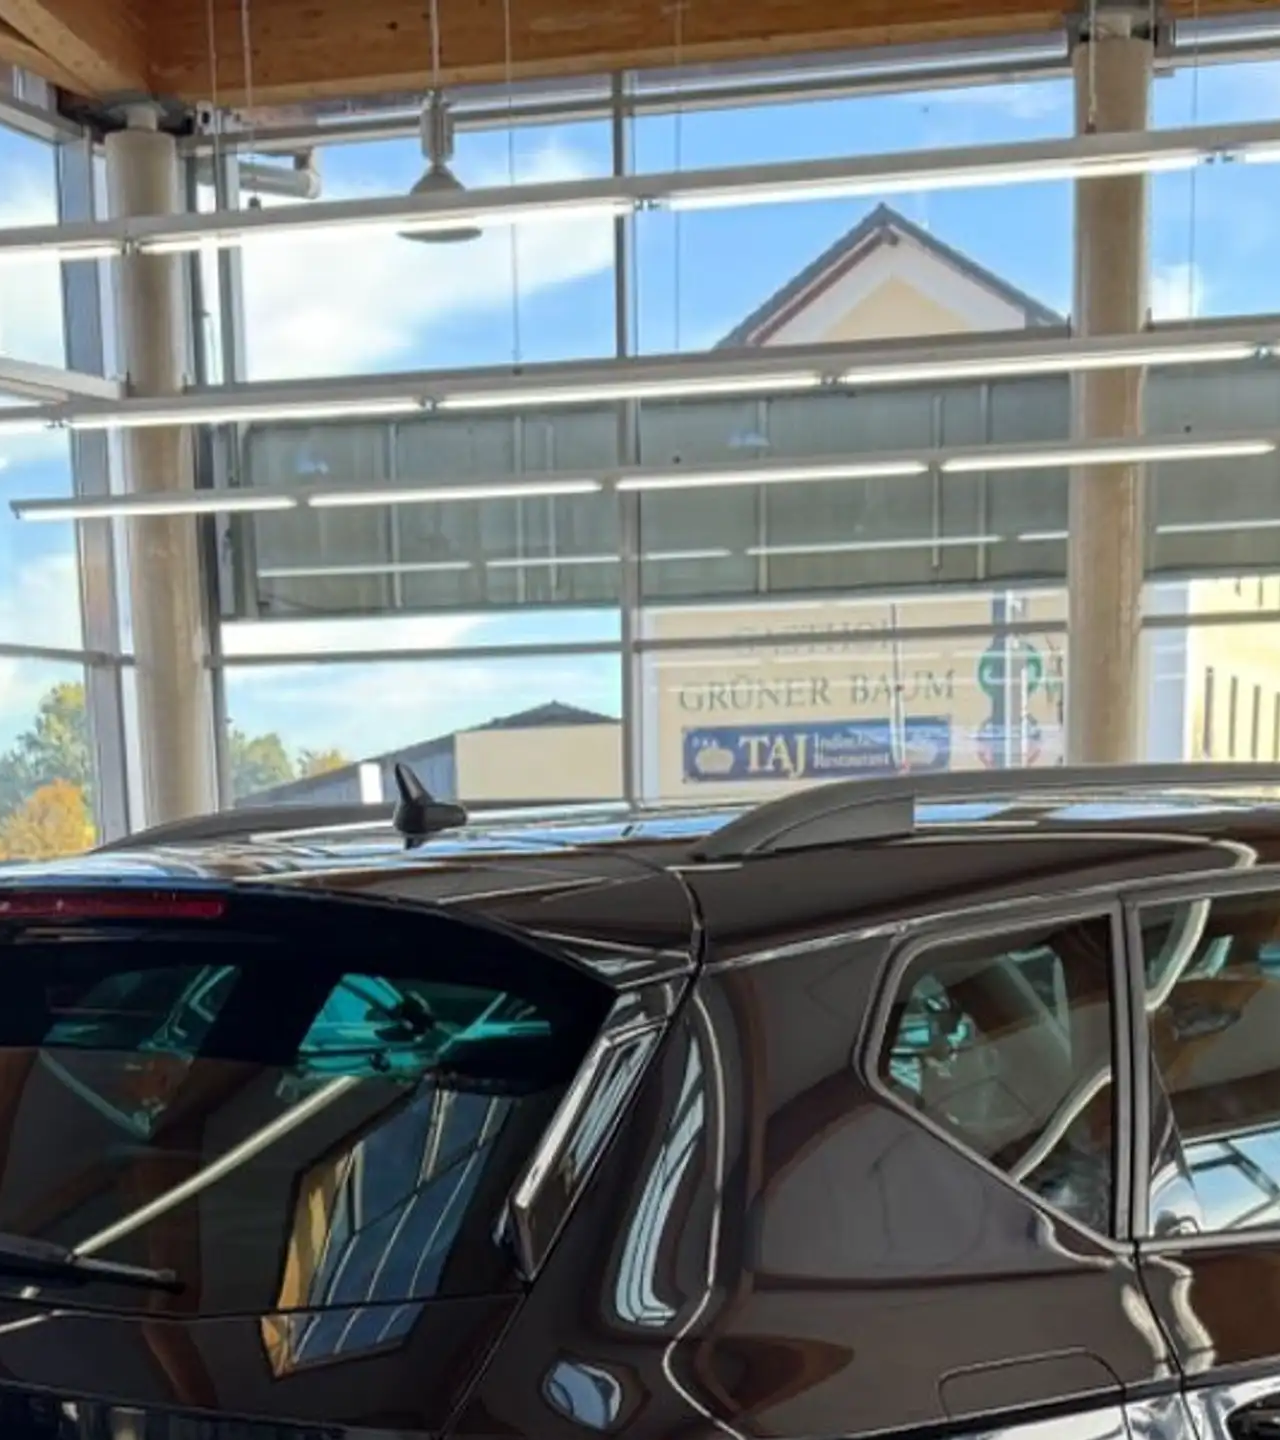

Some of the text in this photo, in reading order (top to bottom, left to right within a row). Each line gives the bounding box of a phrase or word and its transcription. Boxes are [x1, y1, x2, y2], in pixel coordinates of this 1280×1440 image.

[680, 667, 955, 712] GRÜNER BAUM
[739, 734, 811, 778] TAJ
